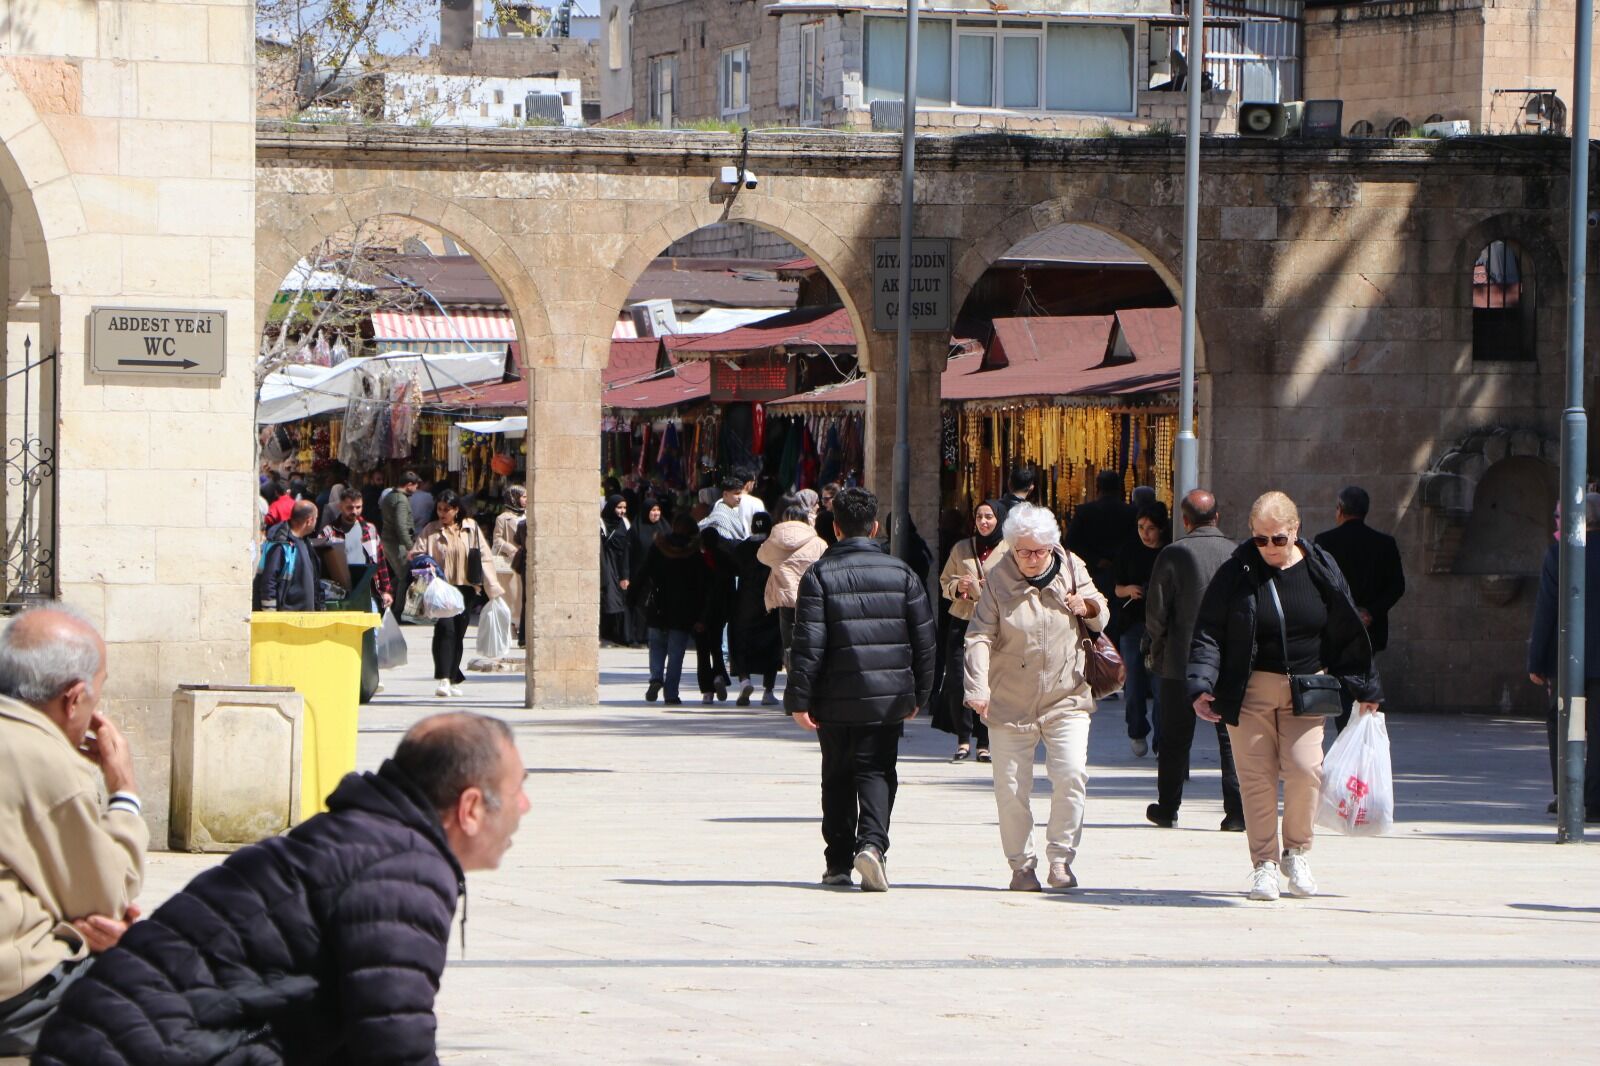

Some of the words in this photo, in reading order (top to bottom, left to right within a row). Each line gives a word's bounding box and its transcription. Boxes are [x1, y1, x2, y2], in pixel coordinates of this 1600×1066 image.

[876, 251, 946, 268] ZİYDDİN
[881, 278, 941, 292] AKULUT
[108, 316, 170, 332] ABDEST
[174, 316, 212, 333] YERİ
[143, 337, 176, 356] WC
